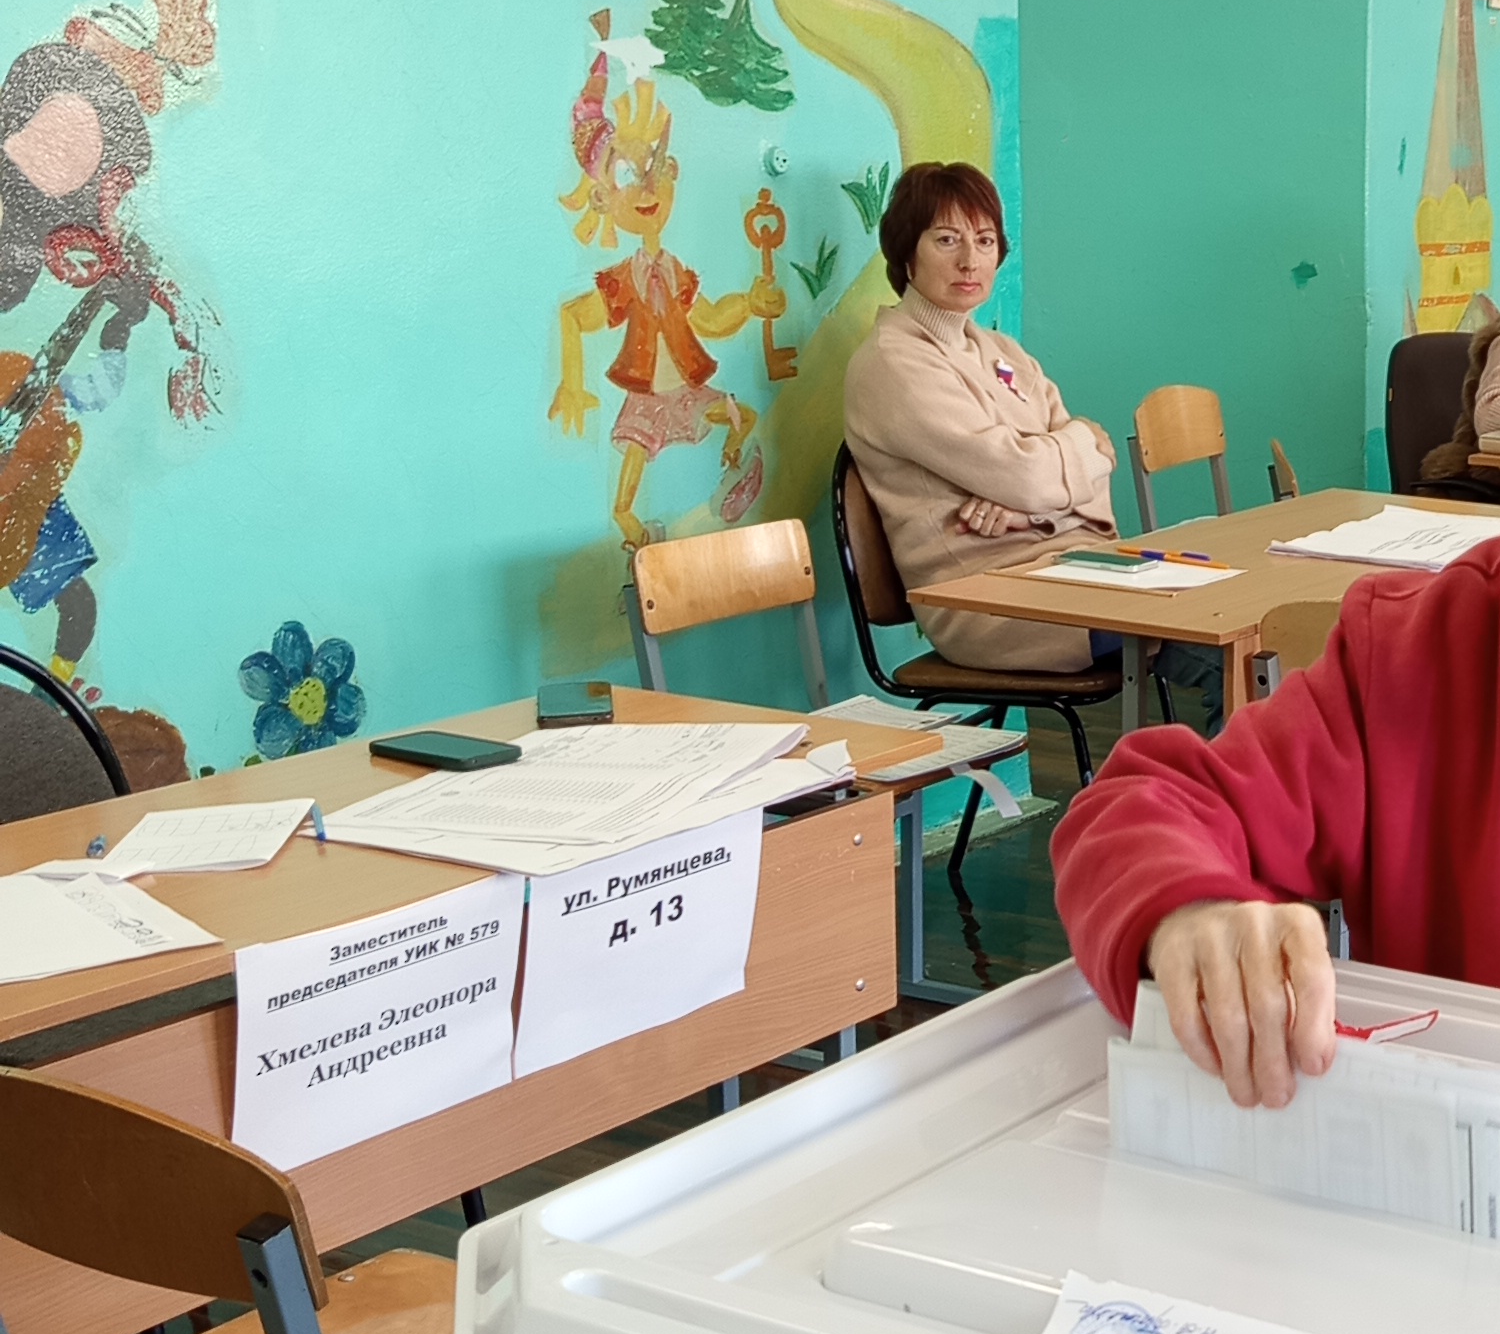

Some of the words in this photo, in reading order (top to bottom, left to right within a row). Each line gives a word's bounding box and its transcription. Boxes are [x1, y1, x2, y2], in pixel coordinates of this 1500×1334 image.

[561, 889, 597, 916] ул.
[606, 846, 731, 897] Румянцева,
[330, 915, 448, 962] Заместитель
[608, 919, 637, 947] д.
[650, 895, 683, 927] 13
[267, 956, 398, 1011] председателя
[404, 939, 440, 964] УИК
[444, 932, 465, 950] №
[470, 919, 500, 941] 579
[256, 1020, 372, 1076] Хмелева
[378, 976, 497, 1031] Элеонора
[306, 1022, 447, 1088] Андреевна
